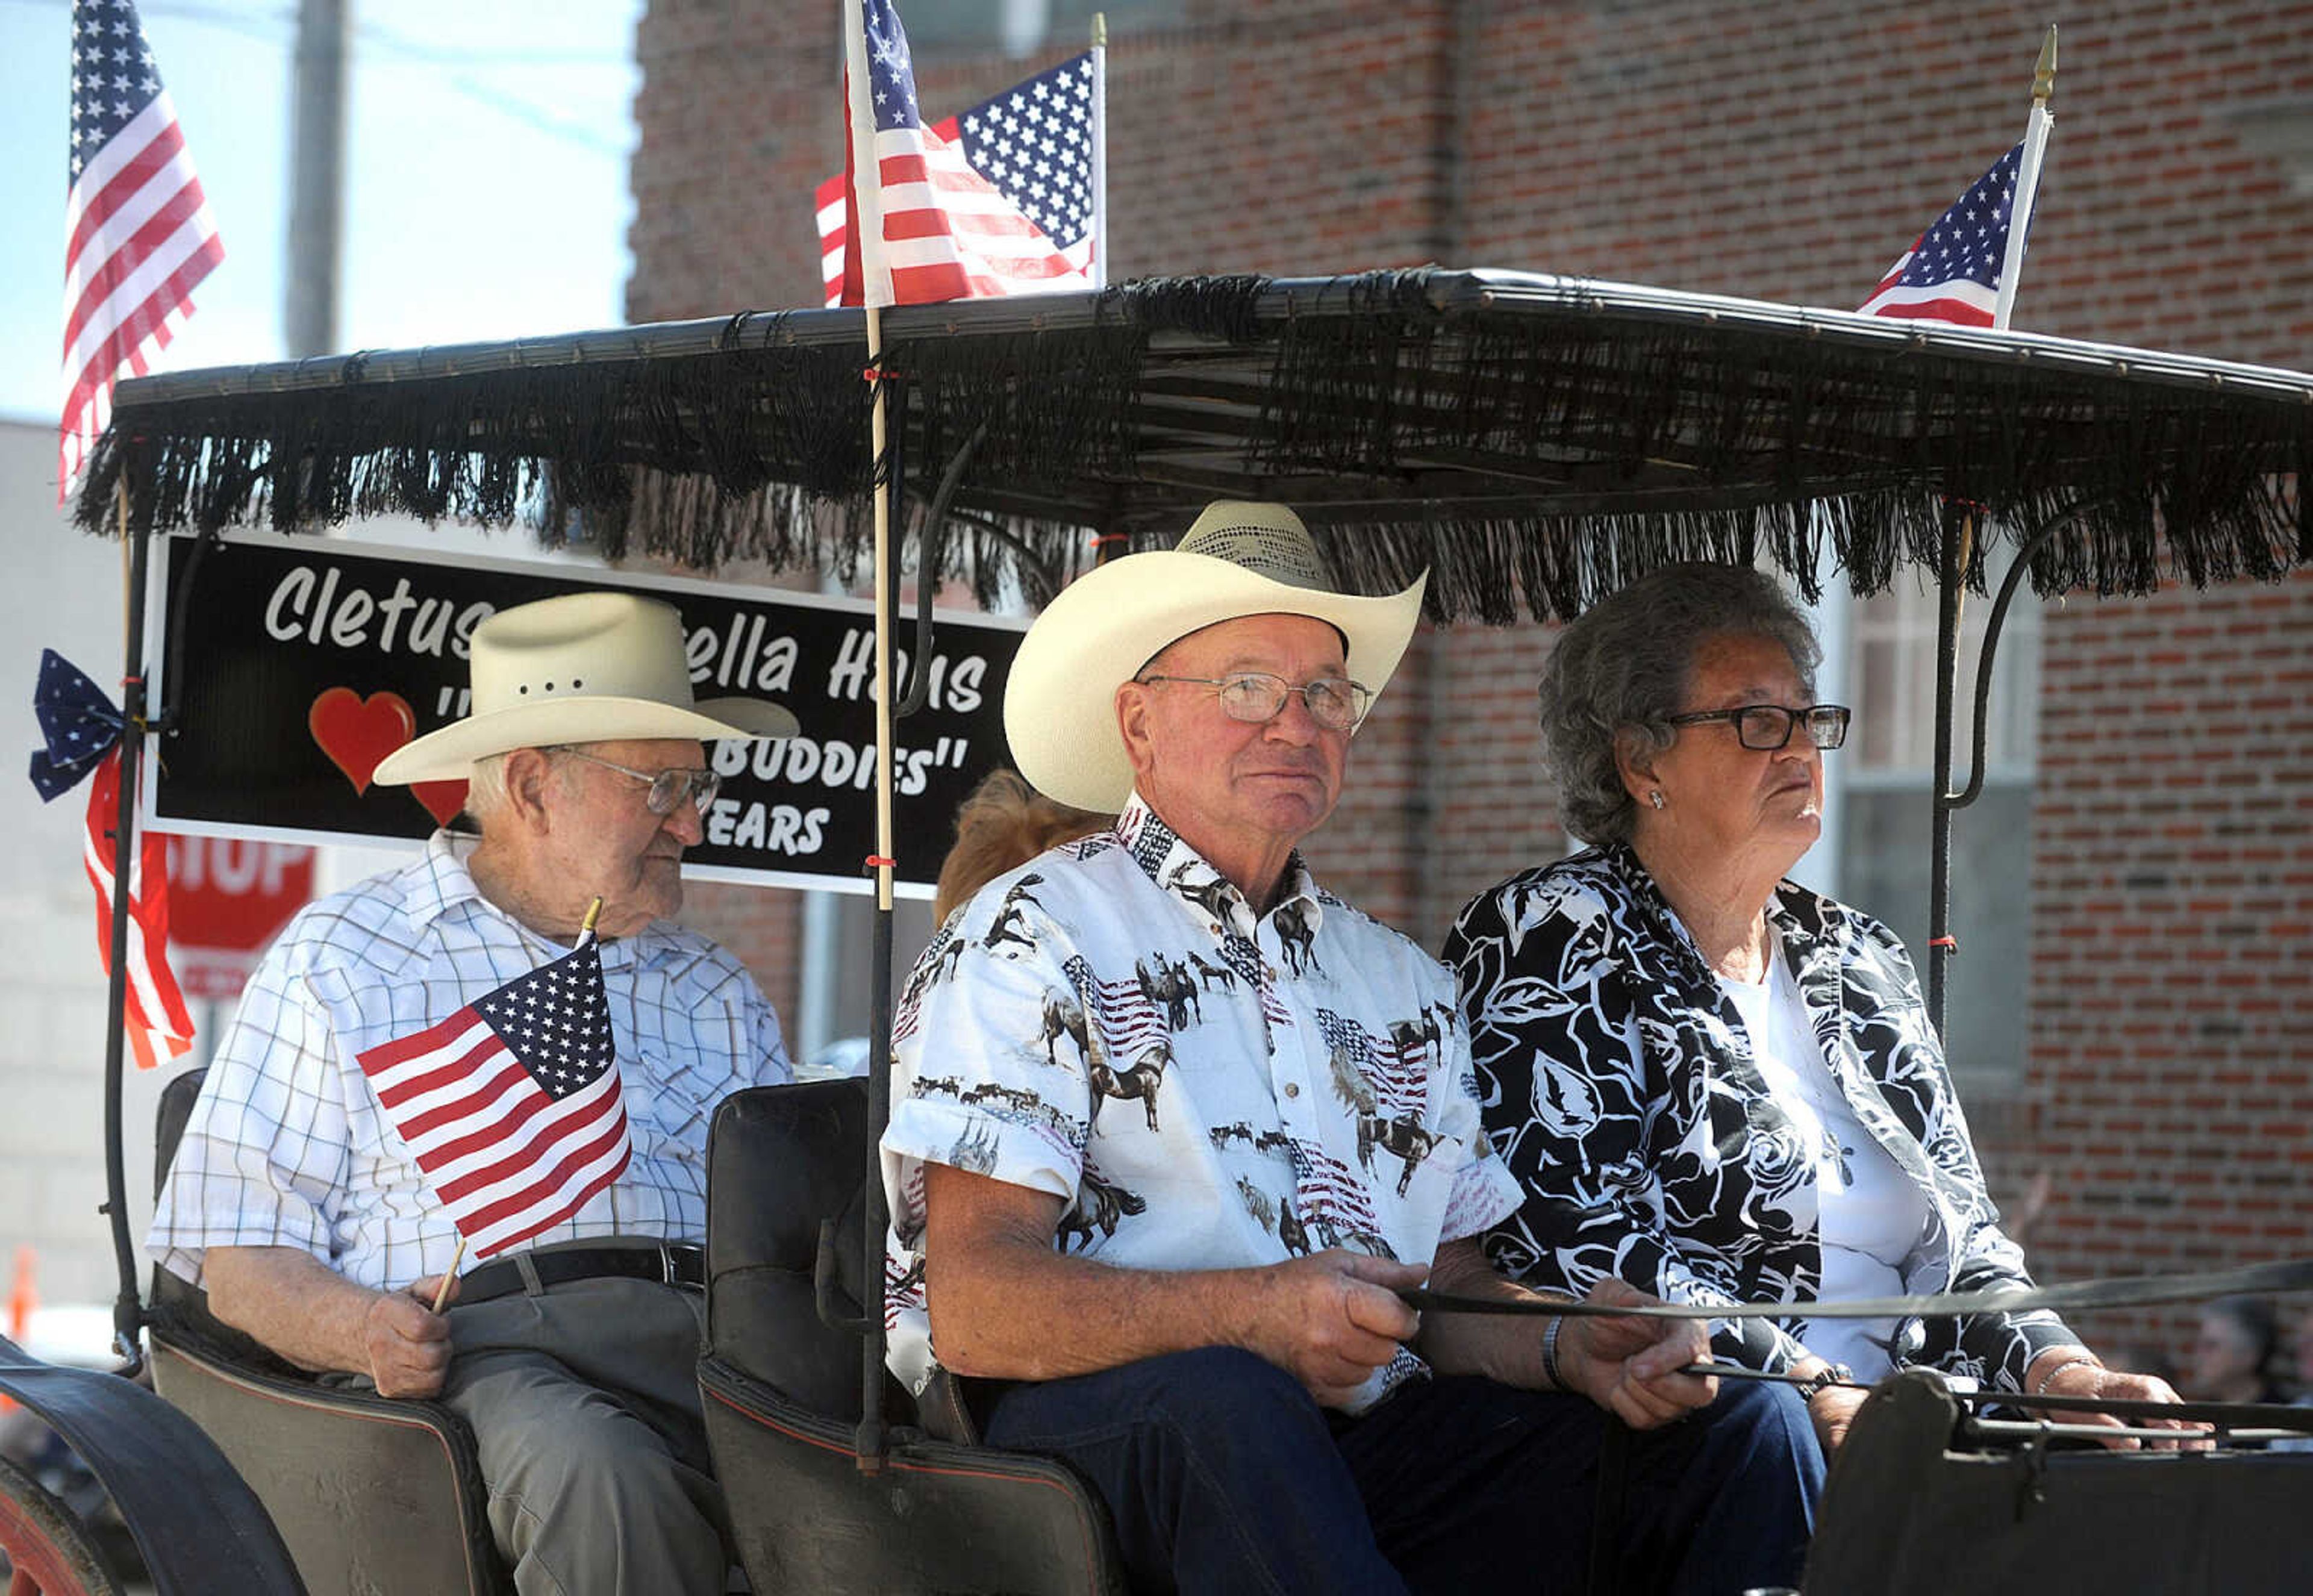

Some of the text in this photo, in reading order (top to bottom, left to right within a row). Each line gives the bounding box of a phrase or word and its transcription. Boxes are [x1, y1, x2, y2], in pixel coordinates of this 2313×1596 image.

[265, 566, 495, 660] Cletus
[682, 612, 799, 692] ella
[696, 789, 831, 856] EARS
